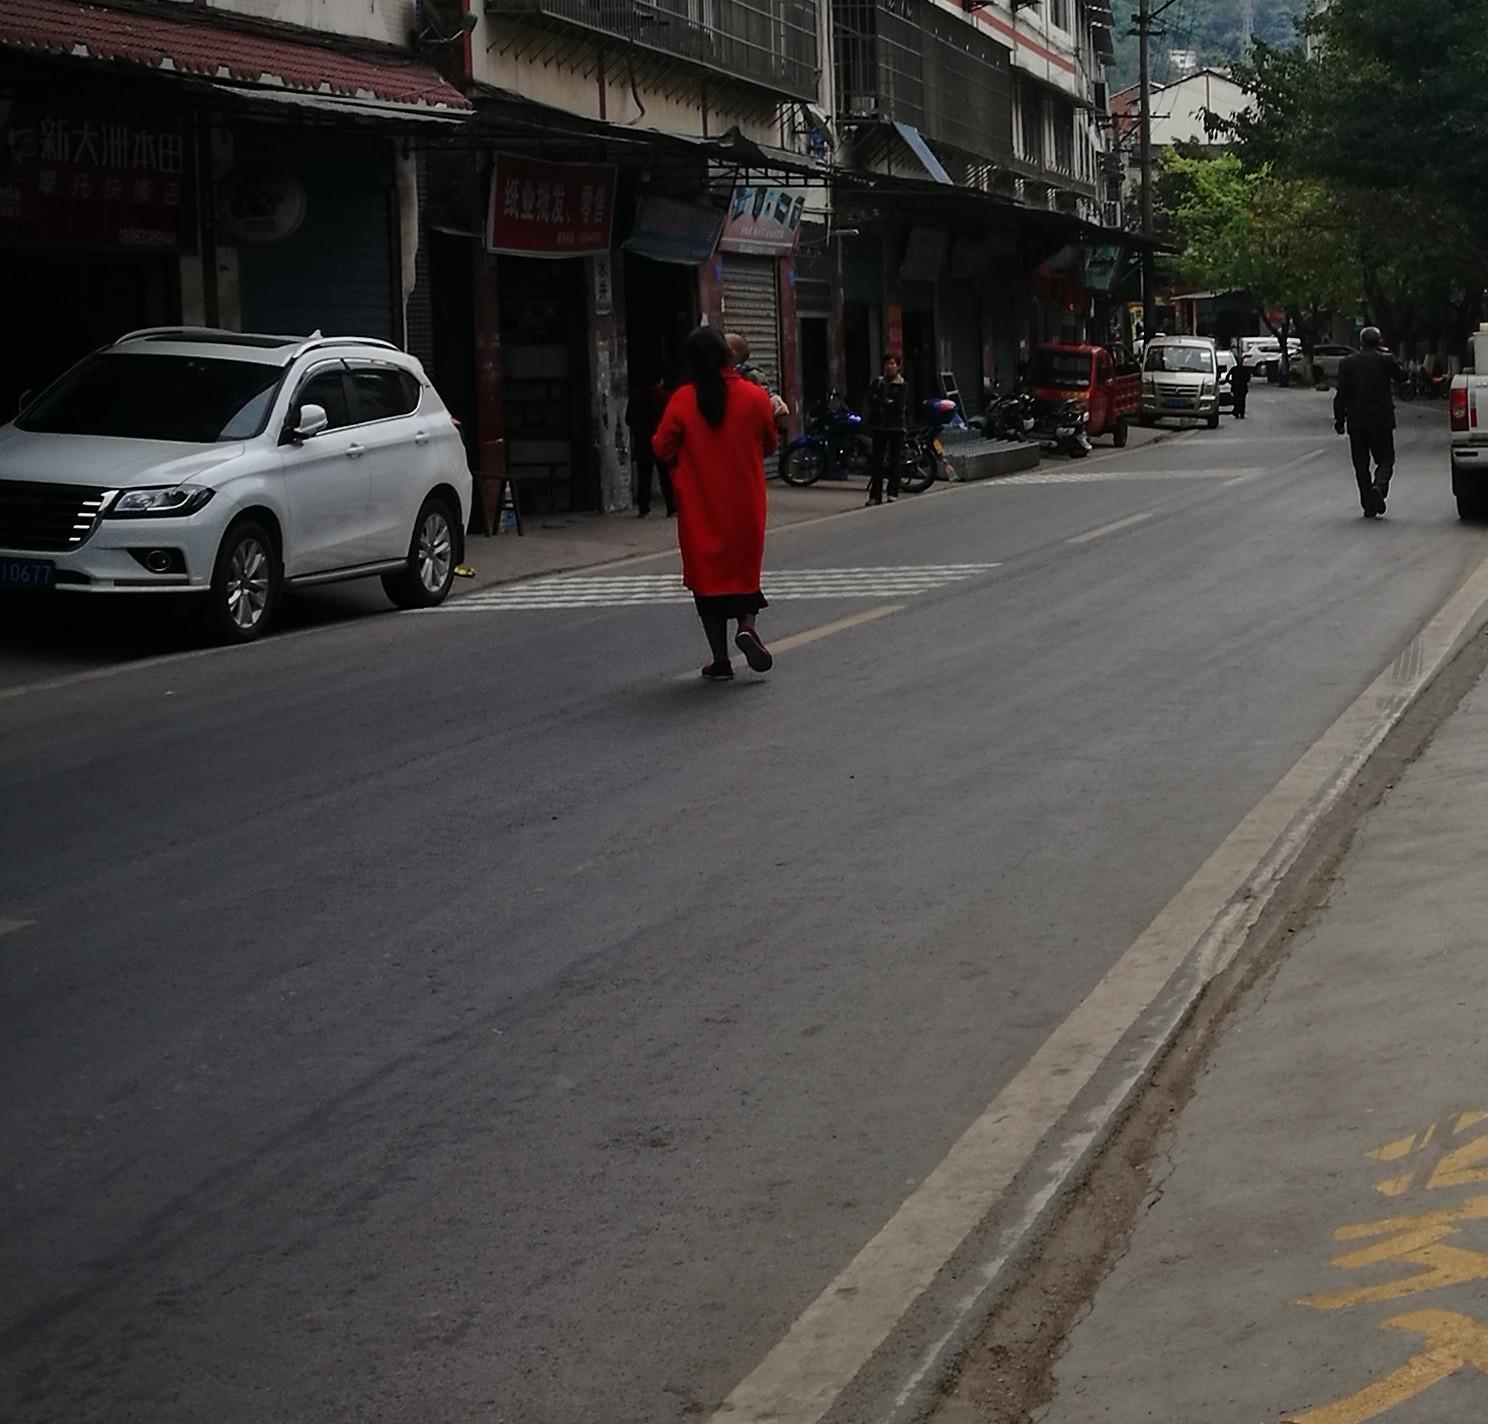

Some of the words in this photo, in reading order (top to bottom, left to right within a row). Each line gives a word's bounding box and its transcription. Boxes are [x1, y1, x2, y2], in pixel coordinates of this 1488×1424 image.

[39, 116, 184, 174] 新大洲本田
